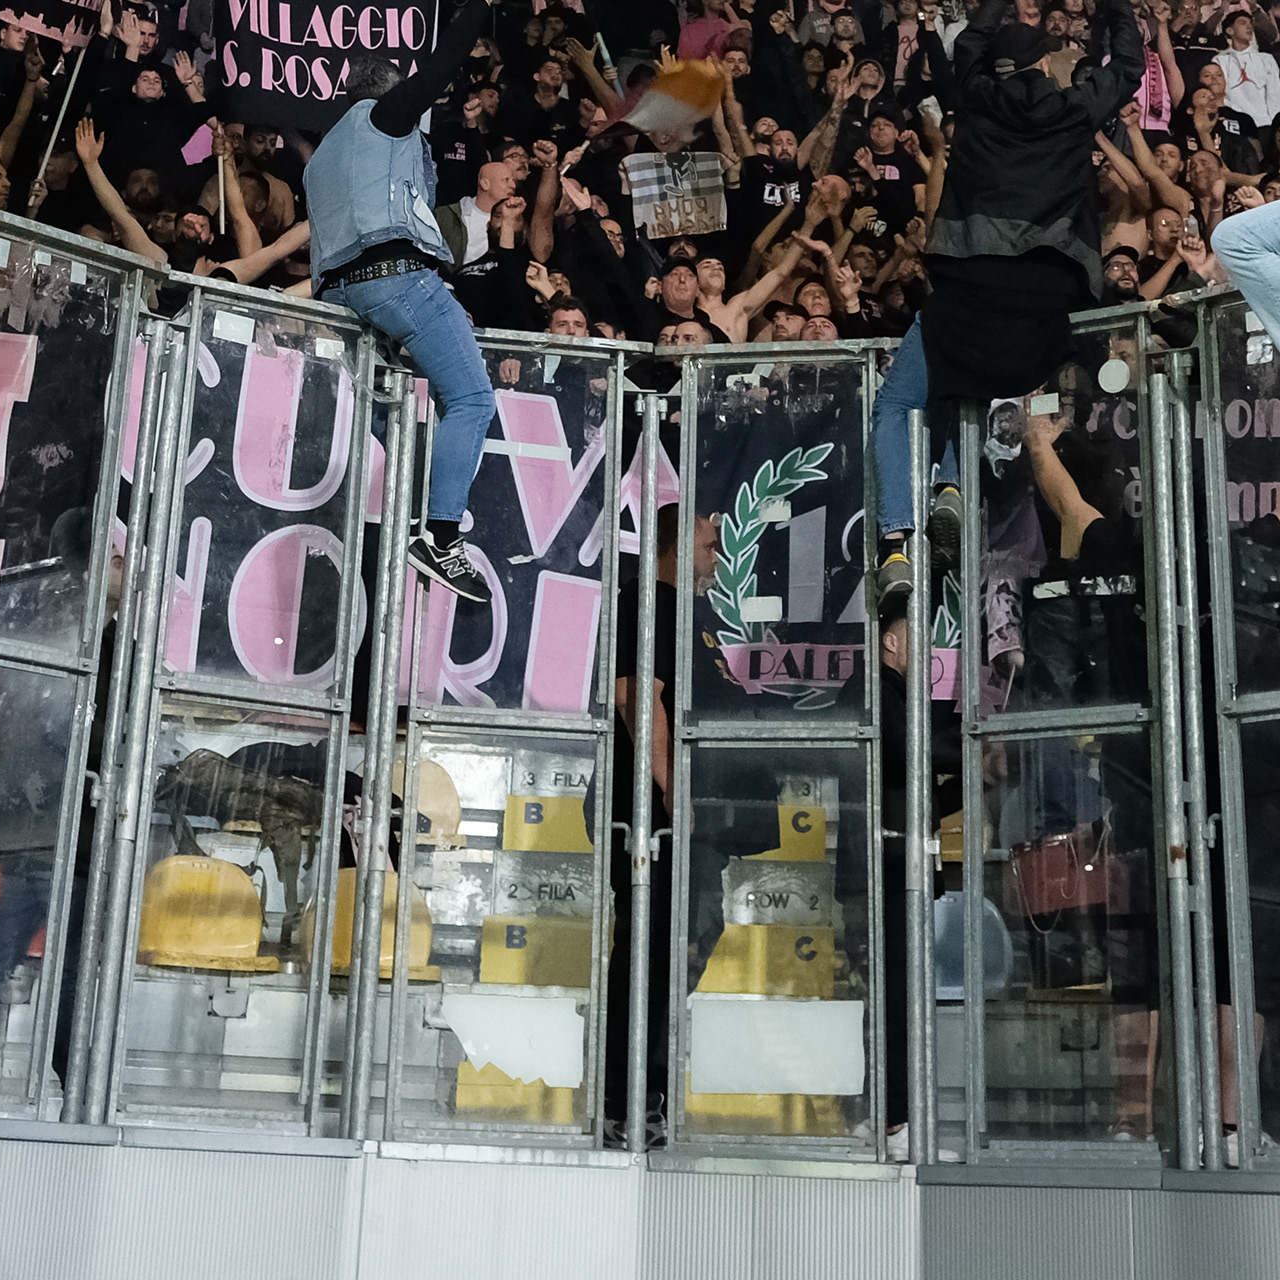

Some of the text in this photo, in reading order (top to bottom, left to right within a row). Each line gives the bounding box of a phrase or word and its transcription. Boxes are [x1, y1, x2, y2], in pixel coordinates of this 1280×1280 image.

[221, 39, 252, 88] S.
[440, 558, 466, 579] N
[553, 772, 589, 788] FILA
[801, 782, 812, 797] 3
[523, 802, 544, 825] B
[791, 810, 813, 834] C
[507, 883, 576, 901] 2 FILA
[746, 892, 820, 911] ROW 2
[505, 924, 528, 949] B
[794, 935, 818, 962] C
